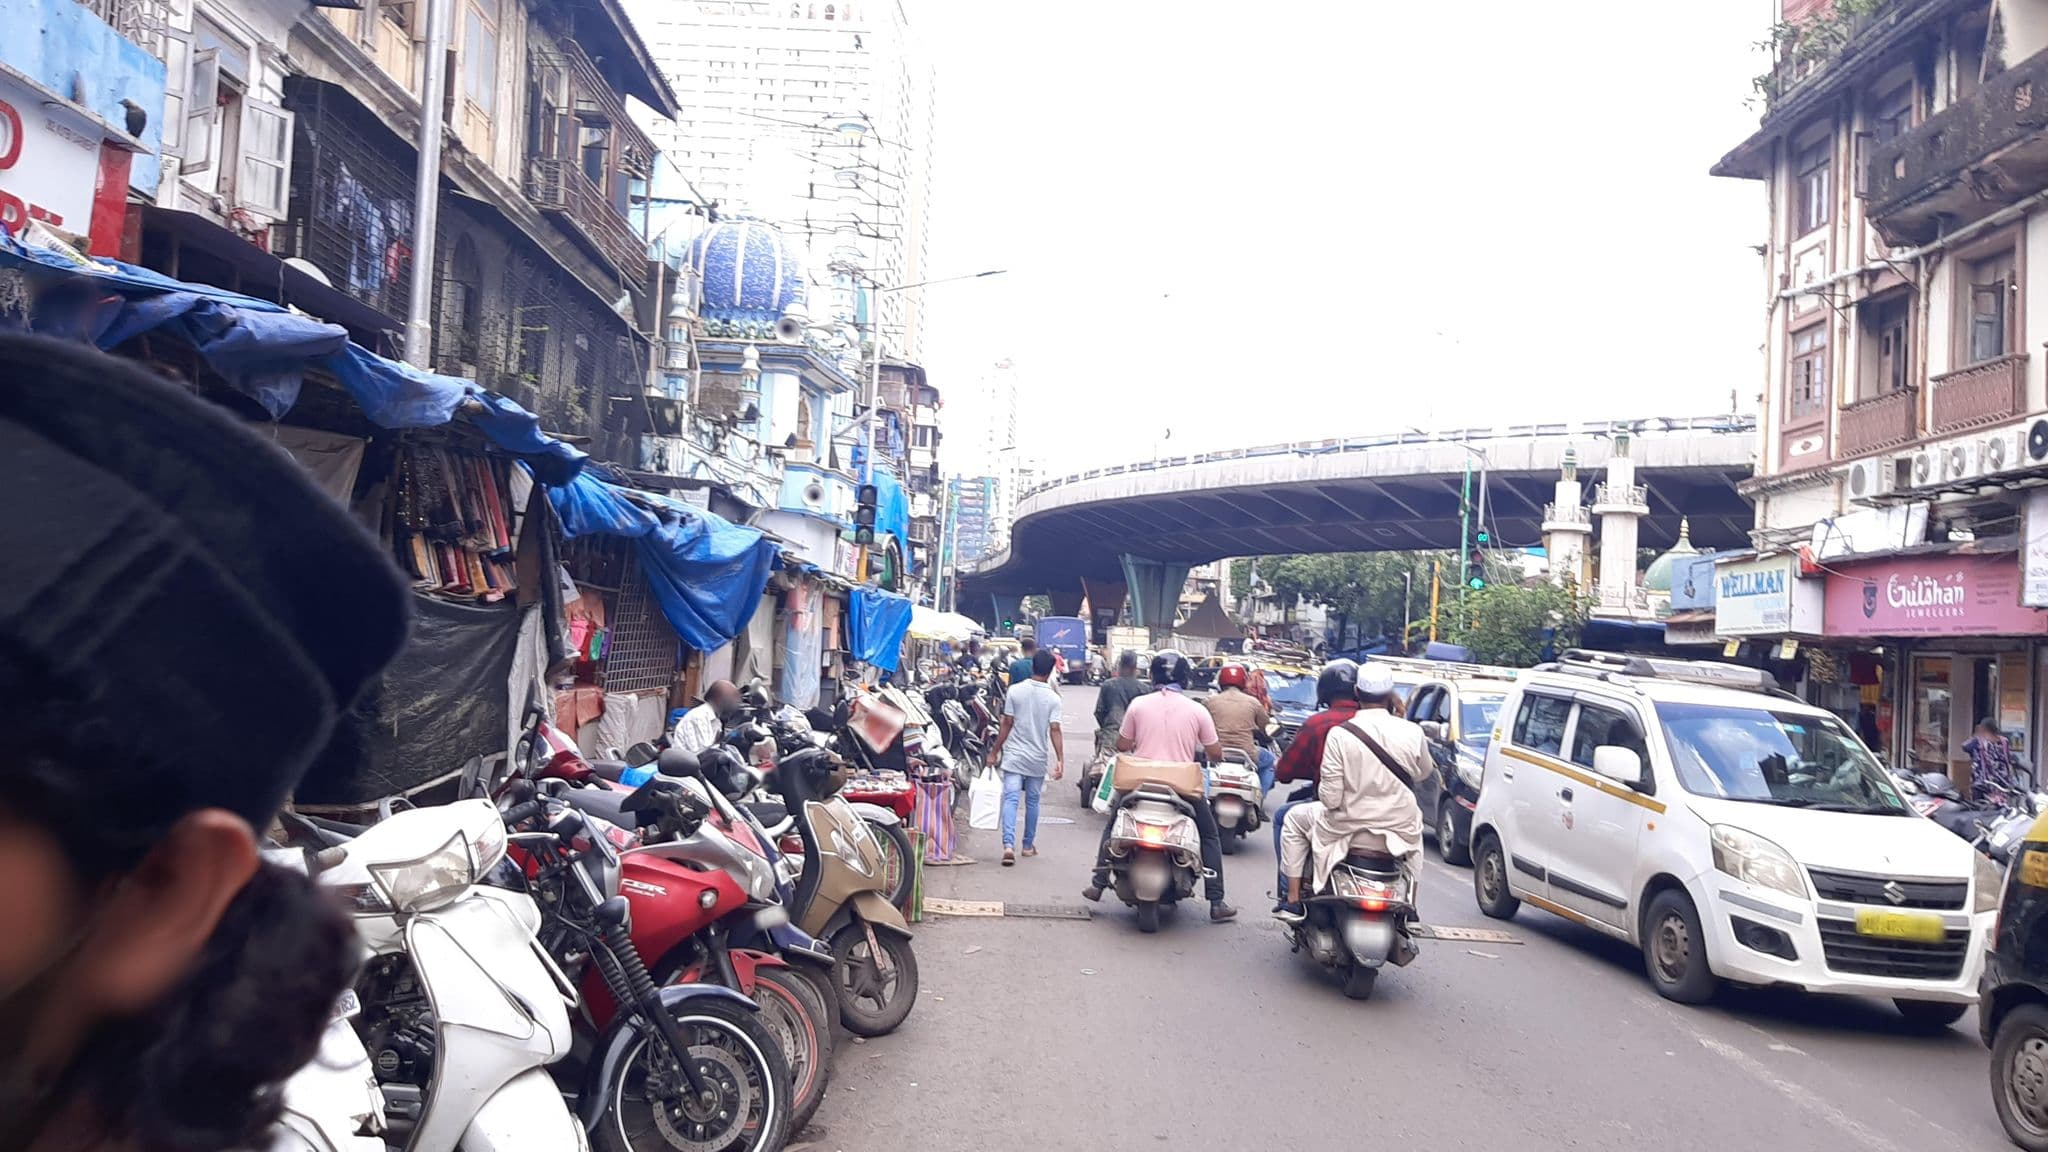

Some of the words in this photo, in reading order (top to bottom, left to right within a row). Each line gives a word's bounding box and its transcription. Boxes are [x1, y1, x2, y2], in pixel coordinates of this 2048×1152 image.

[1721, 568, 1785, 598] WELLMAN
[1886, 573, 1965, 608] Gulshan
[1905, 606, 1965, 618] JEWELLERS
